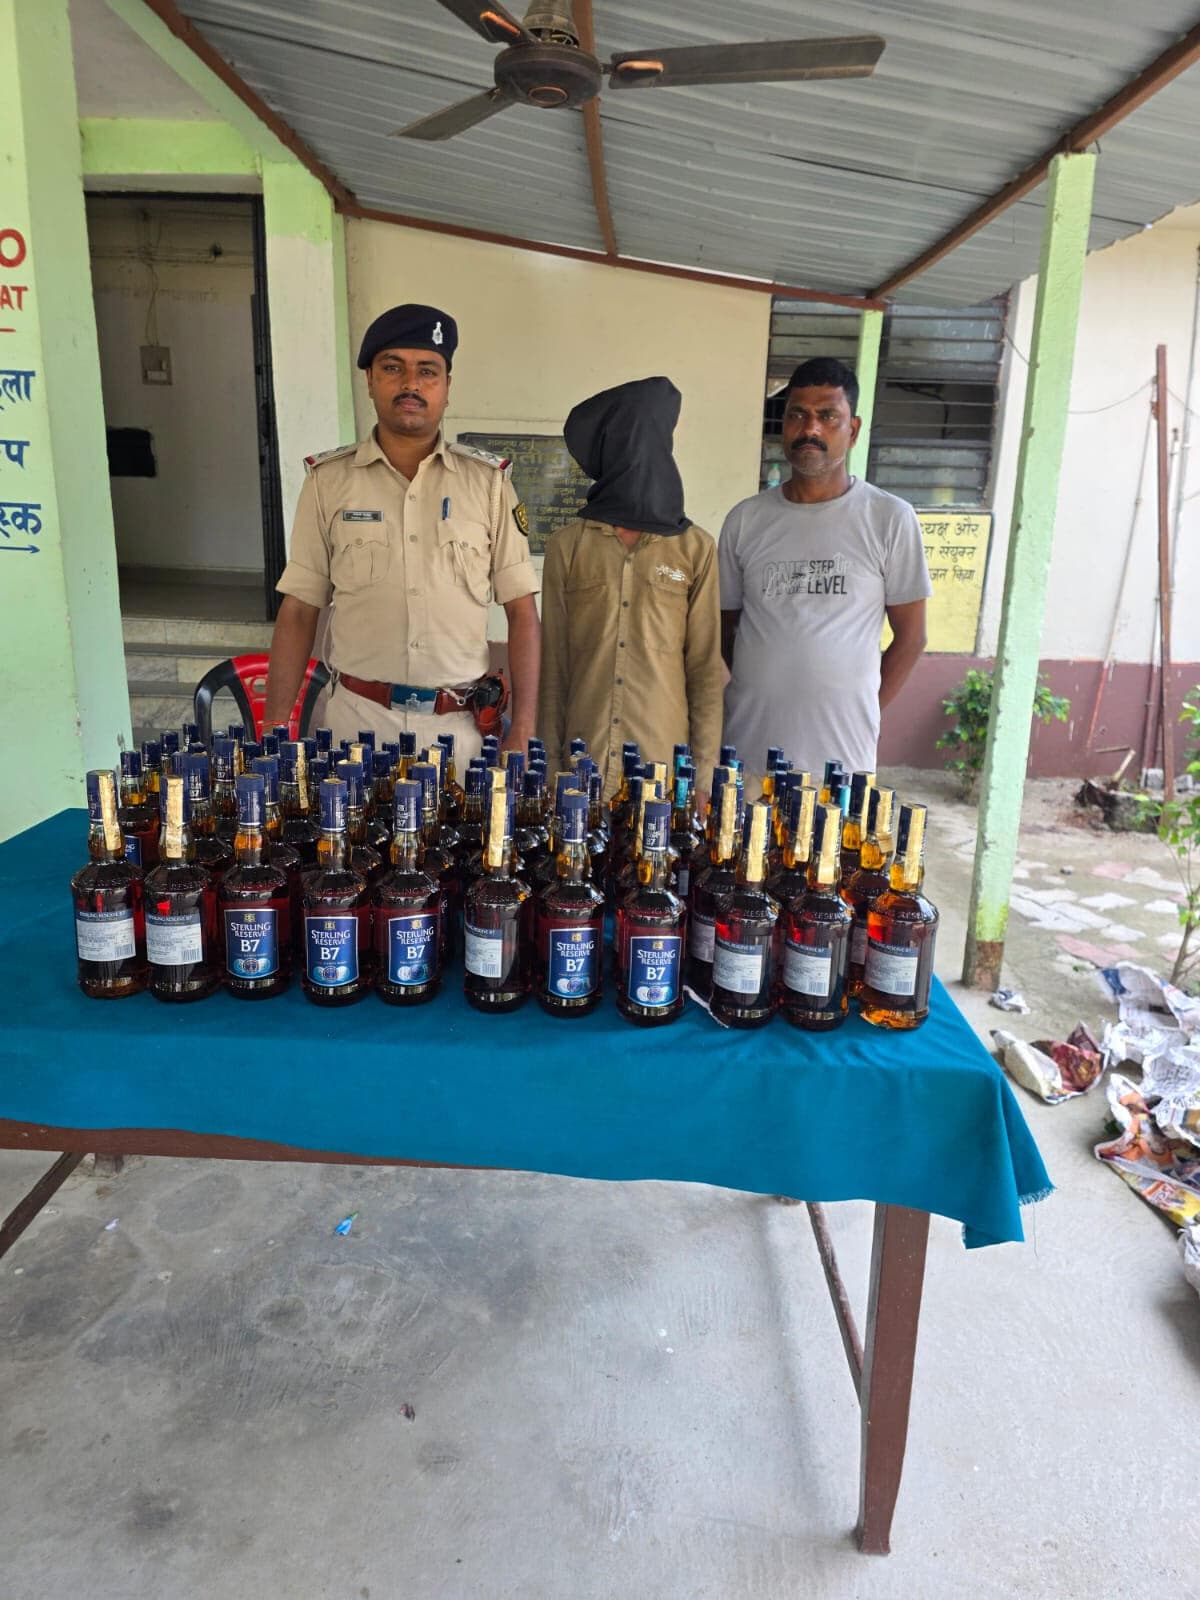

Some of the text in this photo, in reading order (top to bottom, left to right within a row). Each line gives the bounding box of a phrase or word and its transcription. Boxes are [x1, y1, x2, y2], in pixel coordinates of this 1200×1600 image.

[954, 516, 980, 538] और
[808, 559, 834, 574] STEP
[807, 575, 848, 595] LEVEL
[230, 921, 271, 931] STERLING
[234, 930, 268, 938] RESERVE
[311, 929, 351, 940] STERLING
[396, 926, 434, 940] STERLING
[240, 939, 260, 953] B7
[315, 938, 347, 946] RESERVE
[400, 935, 431, 945] RESERVE
[556, 940, 594, 952] STERLING
[320, 946, 340, 961] B7
[407, 944, 426, 960] B7
[560, 950, 591, 958] RESERVE
[636, 949, 676, 960] STERLING
[566, 958, 585, 972] B7
[641, 957, 673, 966] RESERVE
[646, 966, 666, 981] B7
